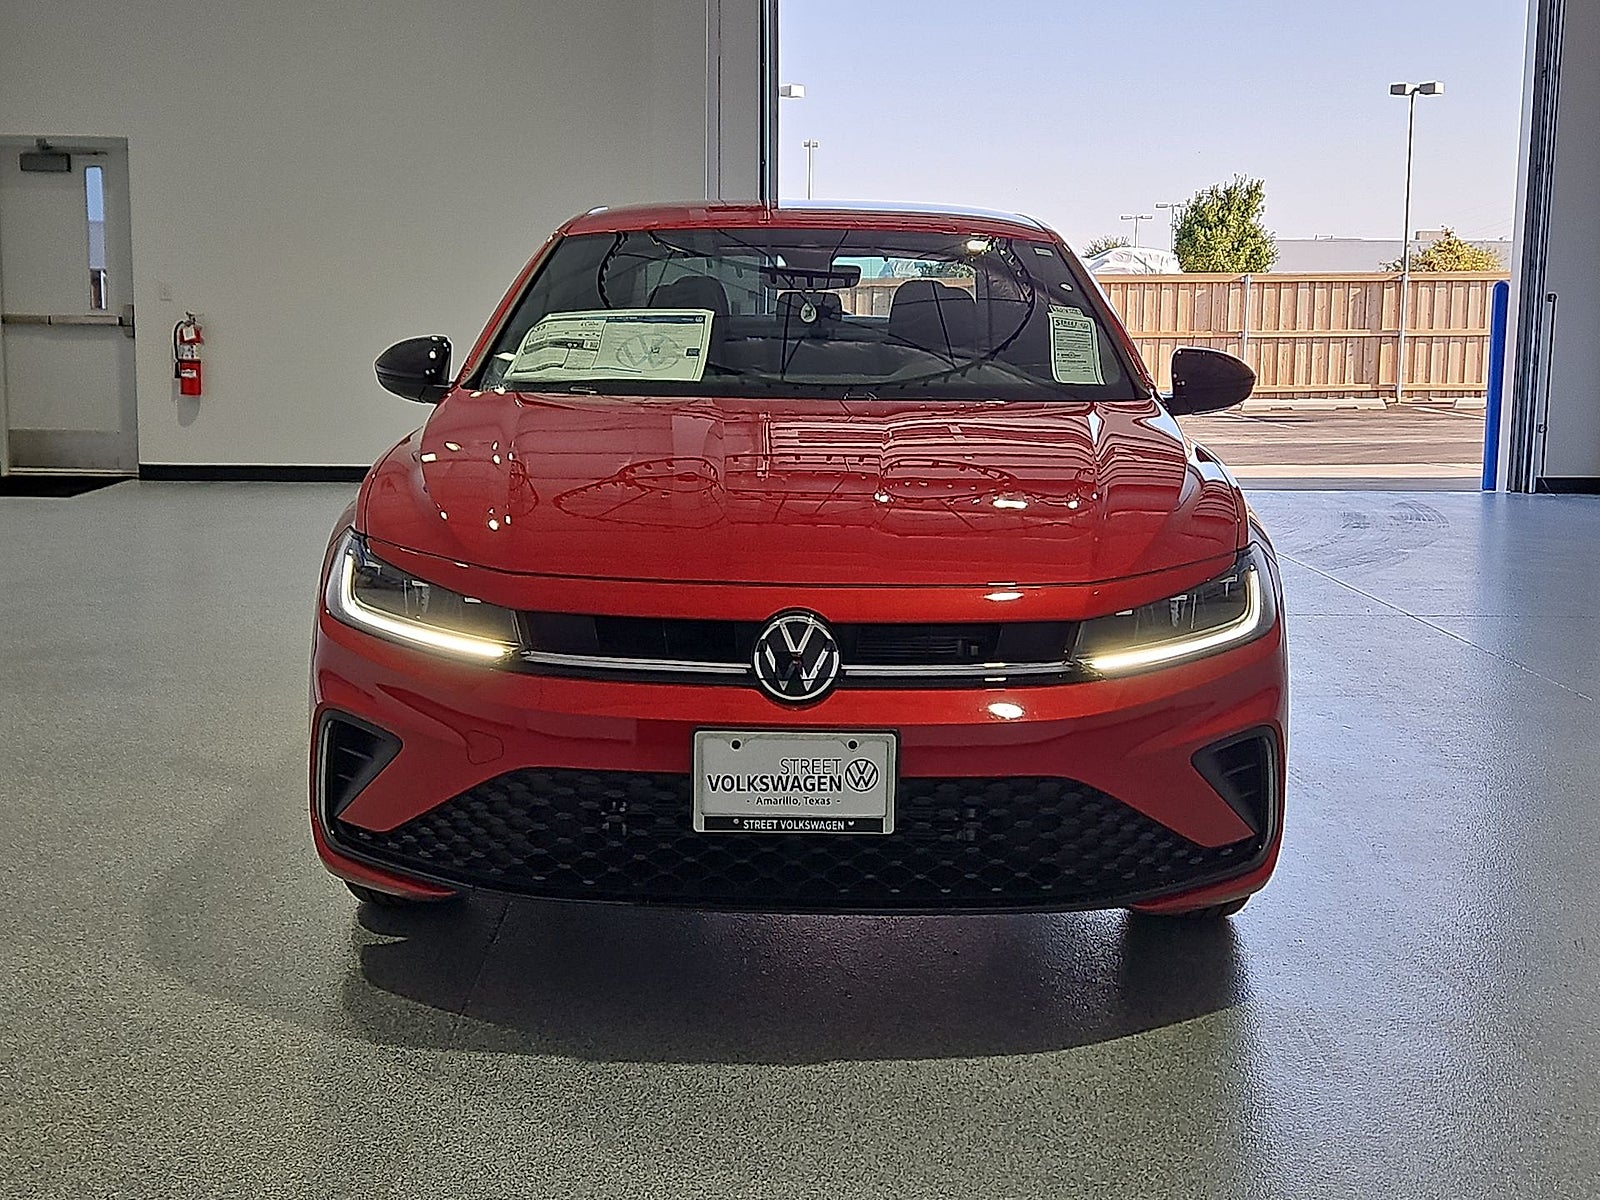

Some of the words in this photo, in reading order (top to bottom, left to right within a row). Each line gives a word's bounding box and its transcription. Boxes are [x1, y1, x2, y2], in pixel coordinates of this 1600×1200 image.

[780, 758, 842, 775] STREET
[707, 775, 842, 792] VOLKSWAGEN
[845, 758, 879, 793] VW
[756, 796, 801, 806] Amarillo,
[803, 797, 831, 805] Texas
[743, 820, 778, 830] STREET
[780, 820, 845, 831] VOLKSWAGEN
